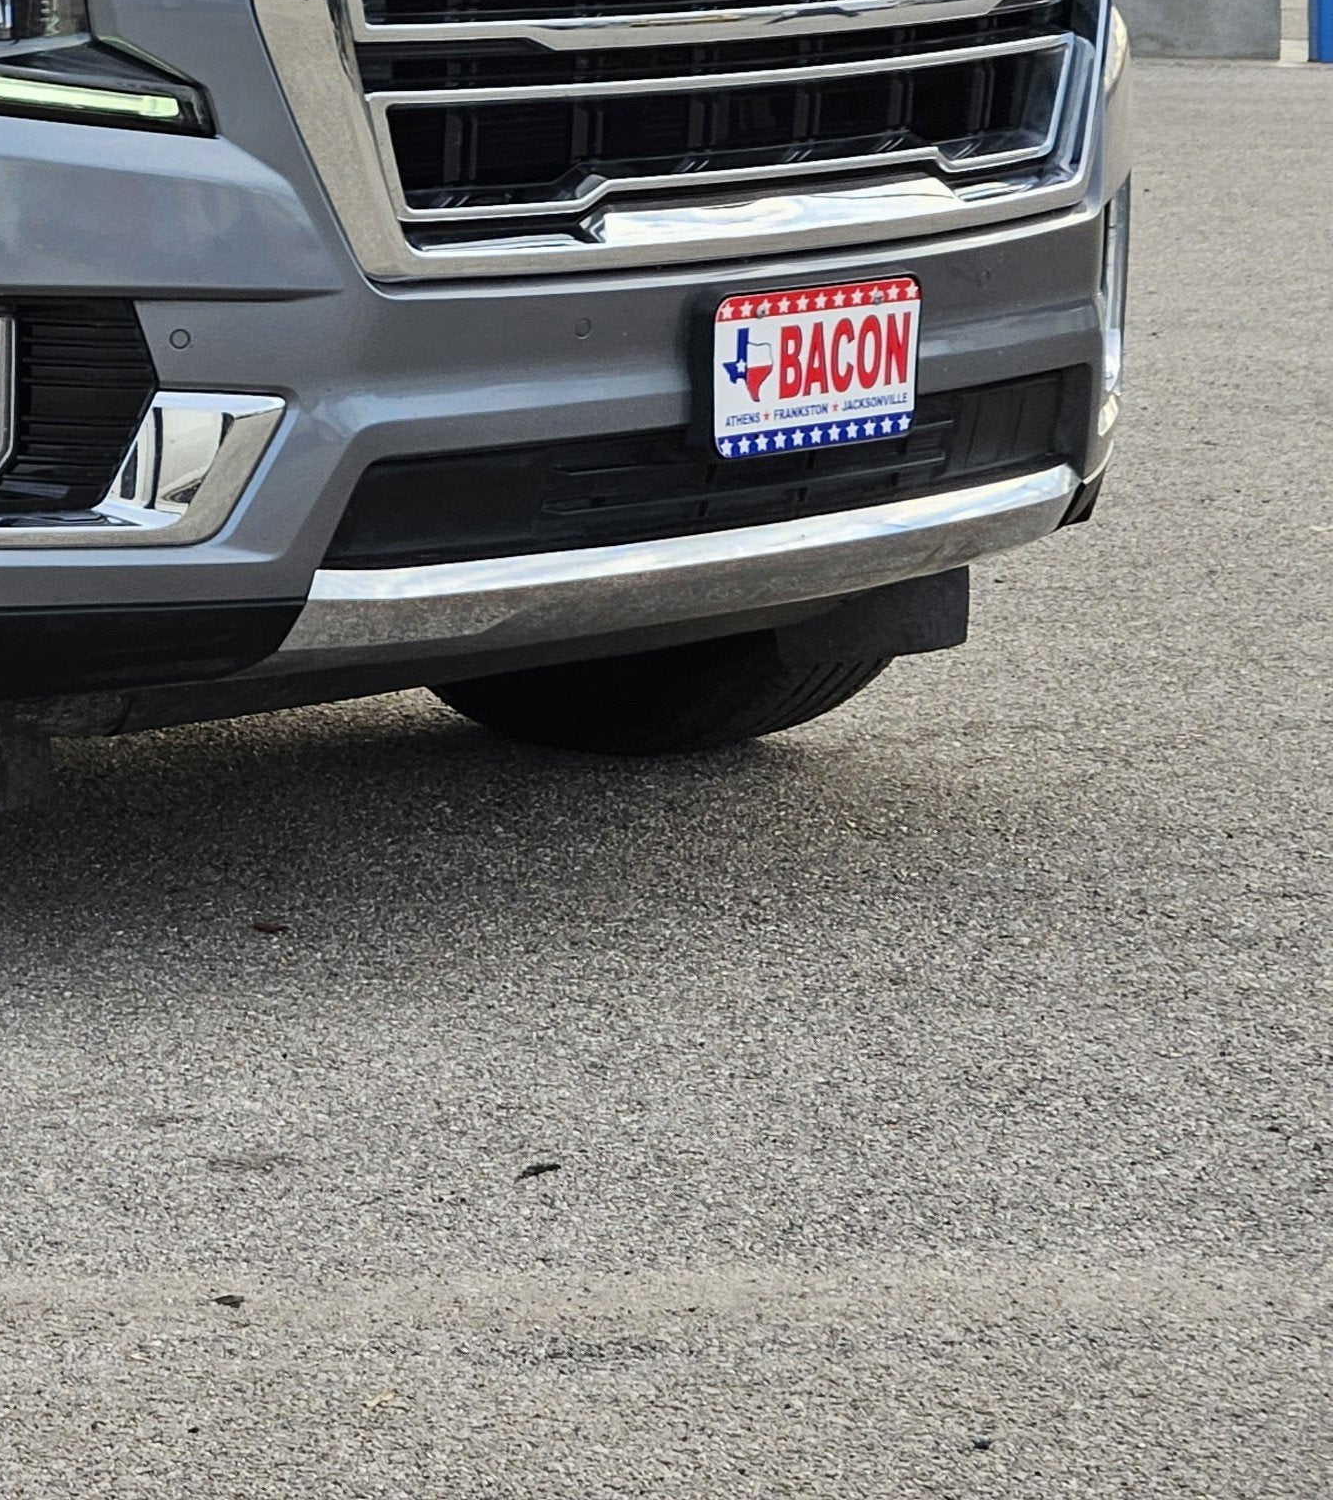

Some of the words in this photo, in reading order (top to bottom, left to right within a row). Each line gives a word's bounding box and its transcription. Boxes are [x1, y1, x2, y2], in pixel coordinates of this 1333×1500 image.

[778, 311, 912, 400] BACON
[724, 412, 761, 427] ATHENS
[773, 402, 829, 420] FRANKSTON
[841, 392, 909, 412] JACKSONVILLE
